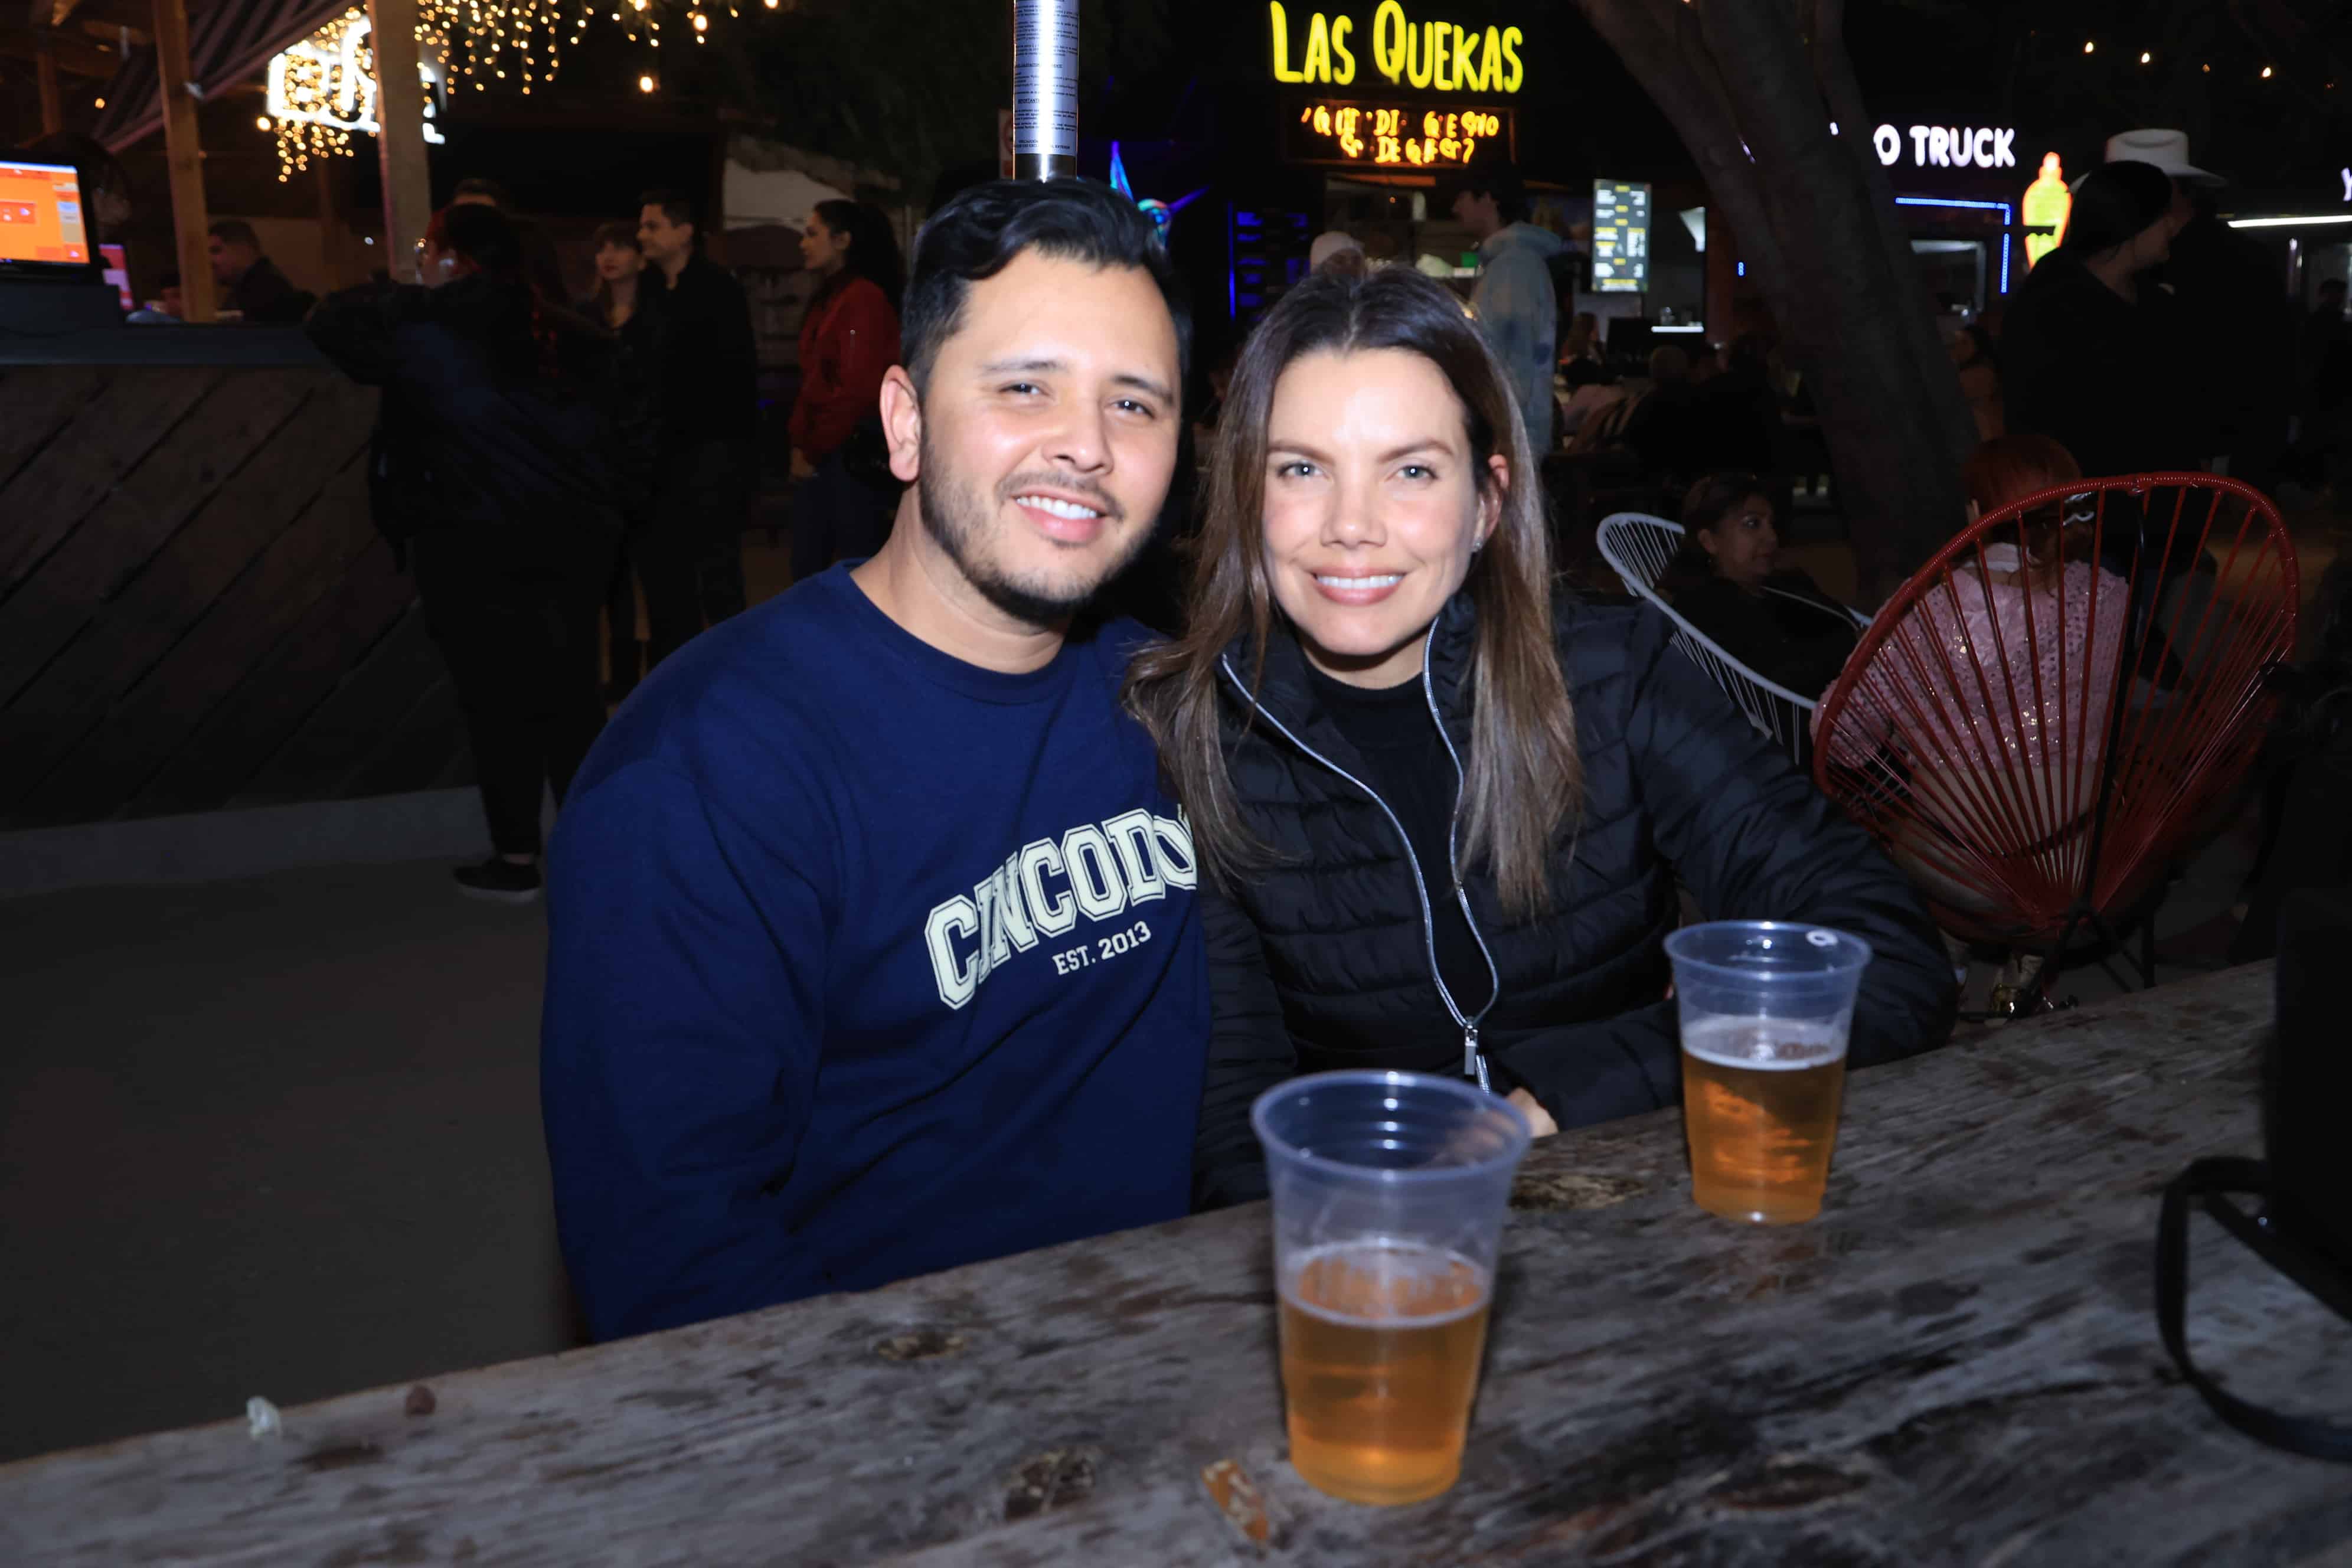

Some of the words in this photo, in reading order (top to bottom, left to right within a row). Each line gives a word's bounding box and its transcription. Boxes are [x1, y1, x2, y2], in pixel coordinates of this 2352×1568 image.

[1270, 1, 1355, 85] LAS
[1373, 0, 1523, 93] QUEKAS
[1909, 125, 2015, 168] TRUCK
[925, 804, 1197, 1010] CINCODO
[1052, 945, 1096, 975] EST.
[1098, 920, 1151, 960] 2013
